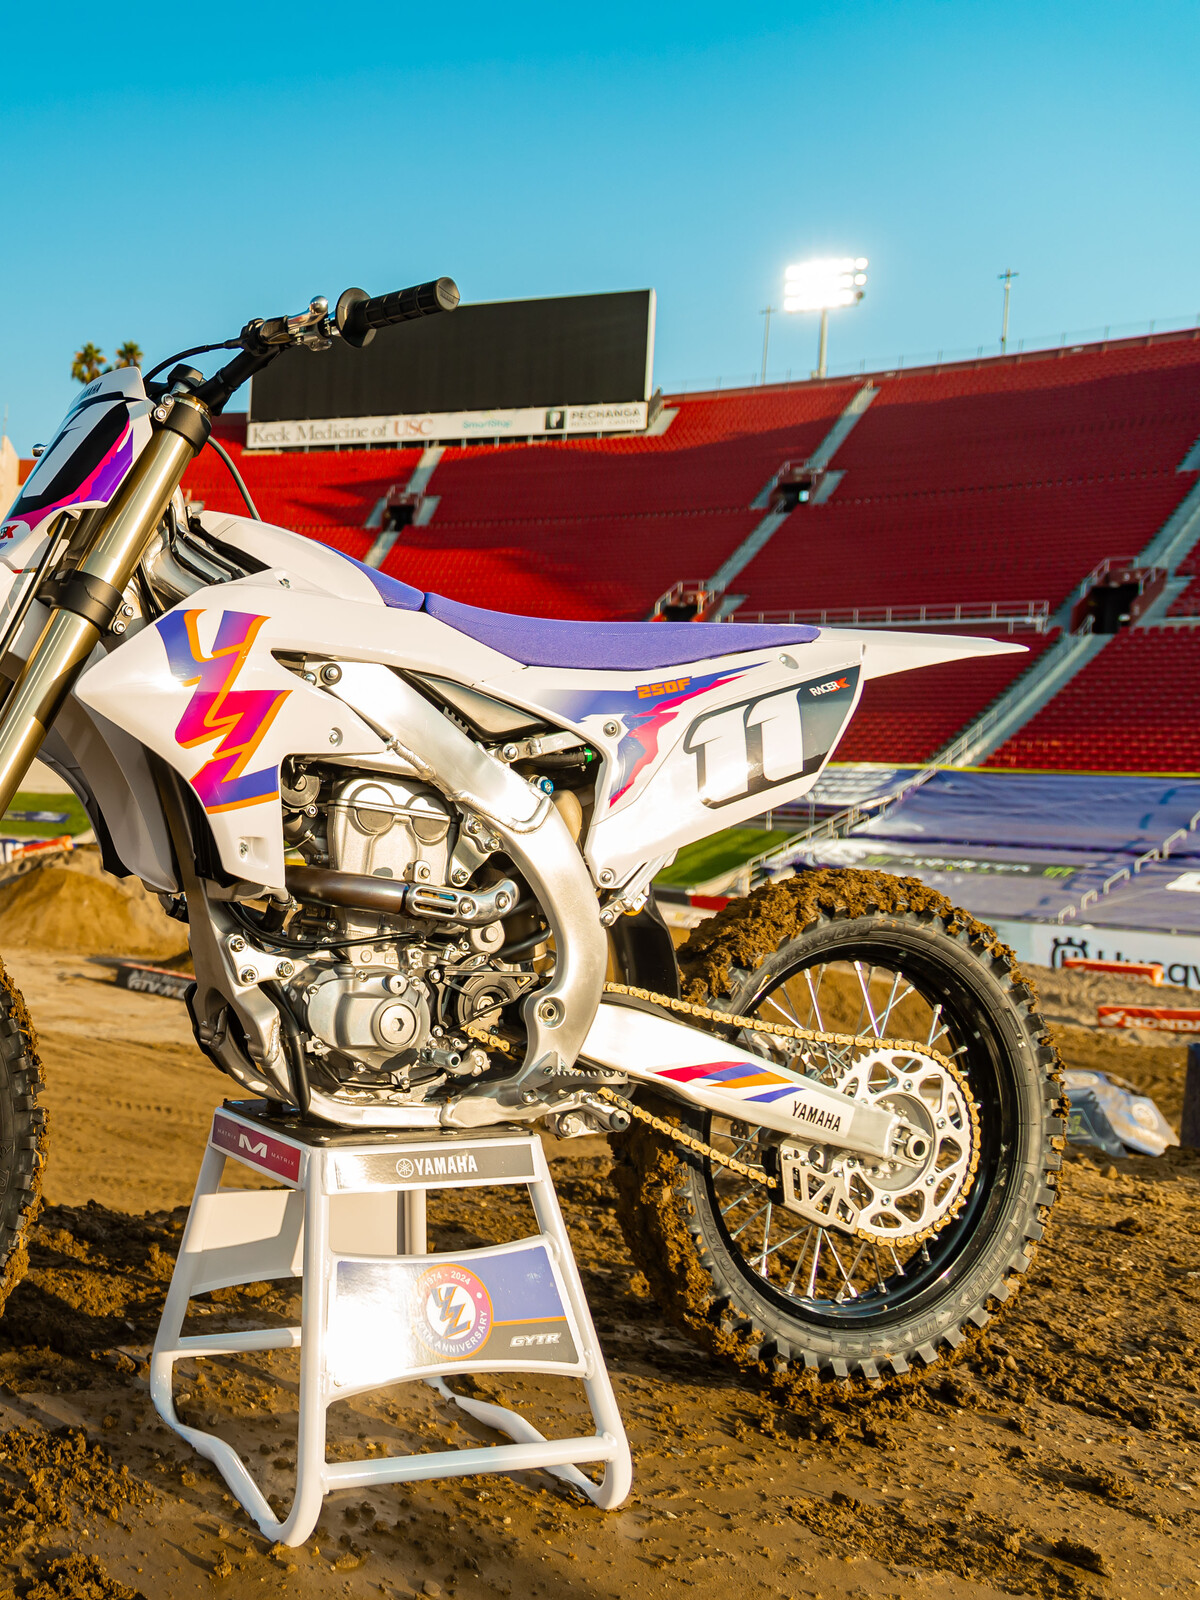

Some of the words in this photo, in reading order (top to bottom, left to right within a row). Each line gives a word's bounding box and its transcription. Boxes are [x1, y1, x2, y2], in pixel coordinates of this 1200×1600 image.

[253, 427, 290, 443] Keck
[296, 423, 369, 441] Medicine
[370, 421, 388, 438] of
[393, 419, 434, 436] USC
[637, 677, 691, 700] 250F
[686, 688, 804, 806] 11
[792, 1100, 841, 1132] YAMAHA
[271, 1152, 295, 1166] MATRIX
[413, 1155, 478, 1176] YAMAHA
[424, 1271, 442, 1287] 1974
[450, 1270, 472, 1285] 2024
[434, 1310, 488, 1353] ANNIVERSARY
[510, 1332, 562, 1348] GYTR
